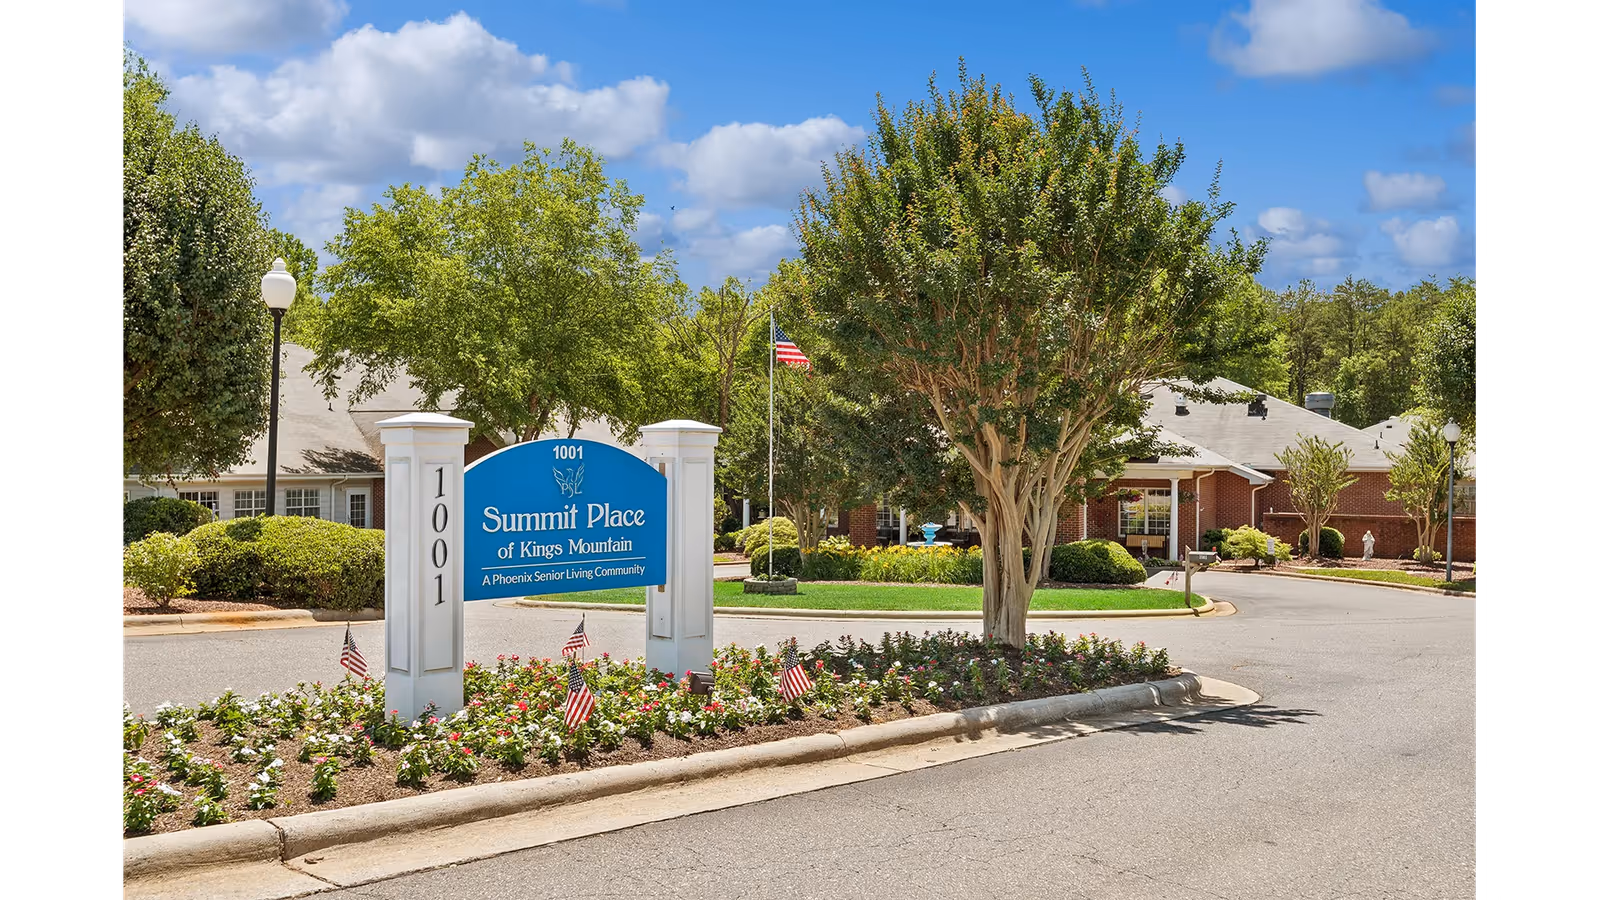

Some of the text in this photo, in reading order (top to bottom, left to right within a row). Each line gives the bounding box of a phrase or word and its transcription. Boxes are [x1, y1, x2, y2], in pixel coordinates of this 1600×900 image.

[553, 445, 583, 460] 1001
[482, 502, 646, 533] Summit Place
[431, 466, 448, 606] 1001
[497, 536, 632, 560] of Kings Mountain
[482, 563, 646, 586] A Phoenix Senior Living Community
